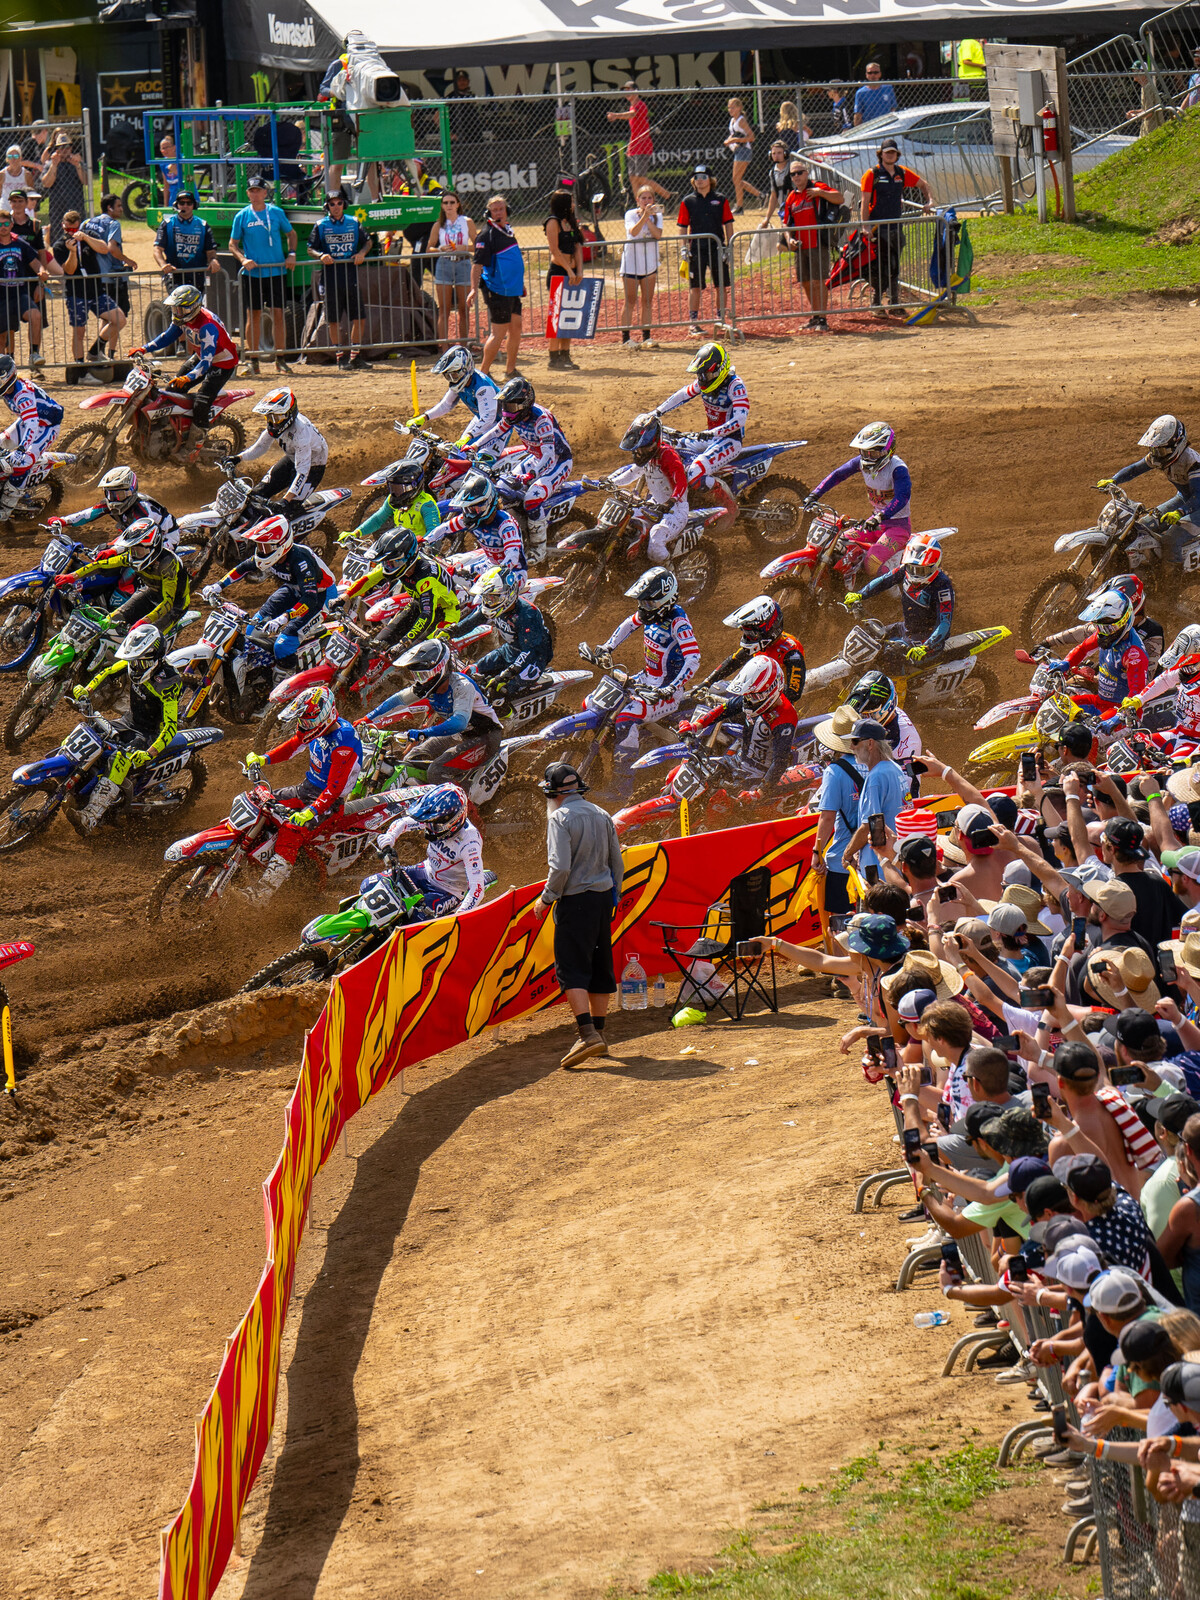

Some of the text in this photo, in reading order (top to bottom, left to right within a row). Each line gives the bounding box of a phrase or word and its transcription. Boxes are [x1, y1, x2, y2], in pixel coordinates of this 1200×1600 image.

[268, 13, 316, 47] Kawasaki
[134, 80, 162, 93] ROC
[329, 243, 352, 253] FXR
[42, 547, 70, 573] 820
[203, 618, 231, 644] 411
[302, 615, 321, 635] SHOT
[518, 697, 547, 720] 511
[65, 727, 98, 761] 434
[151, 756, 183, 782] 434
[479, 757, 509, 793] 350
[673, 769, 702, 799] 91
[364, 889, 399, 920] 81
